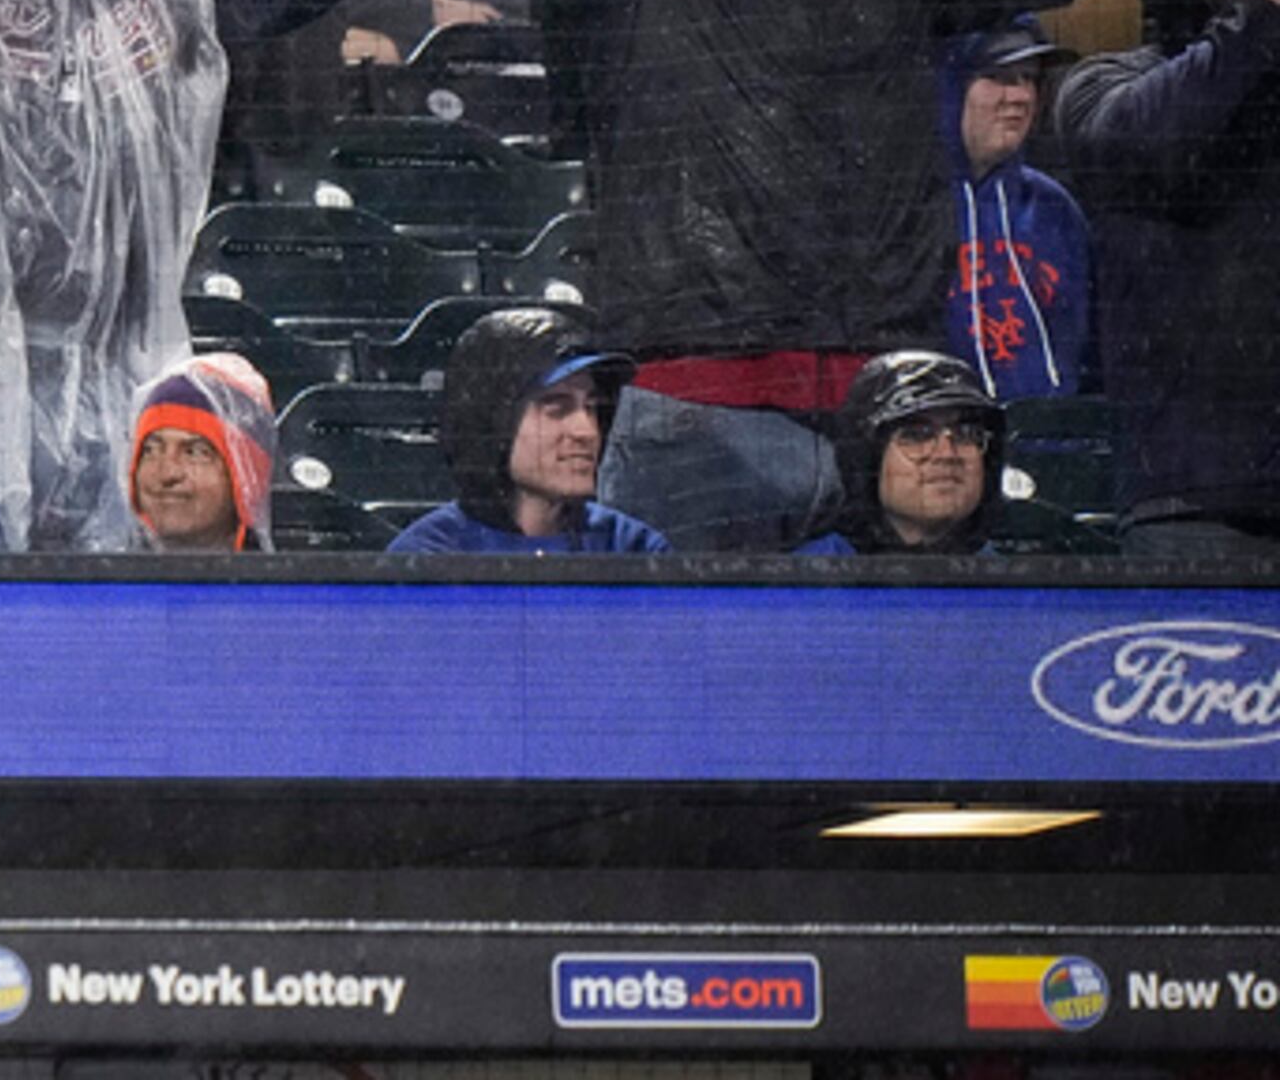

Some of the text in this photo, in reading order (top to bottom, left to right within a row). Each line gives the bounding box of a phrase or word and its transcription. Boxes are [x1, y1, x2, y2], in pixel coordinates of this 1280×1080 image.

[952, 239, 1060, 306] ETS
[47, 963, 143, 1004] New
[148, 964, 245, 1006] York
[251, 966, 405, 1014] Lottery
[570, 970, 804, 1009] mets.com
[1128, 972, 1219, 1009] New
